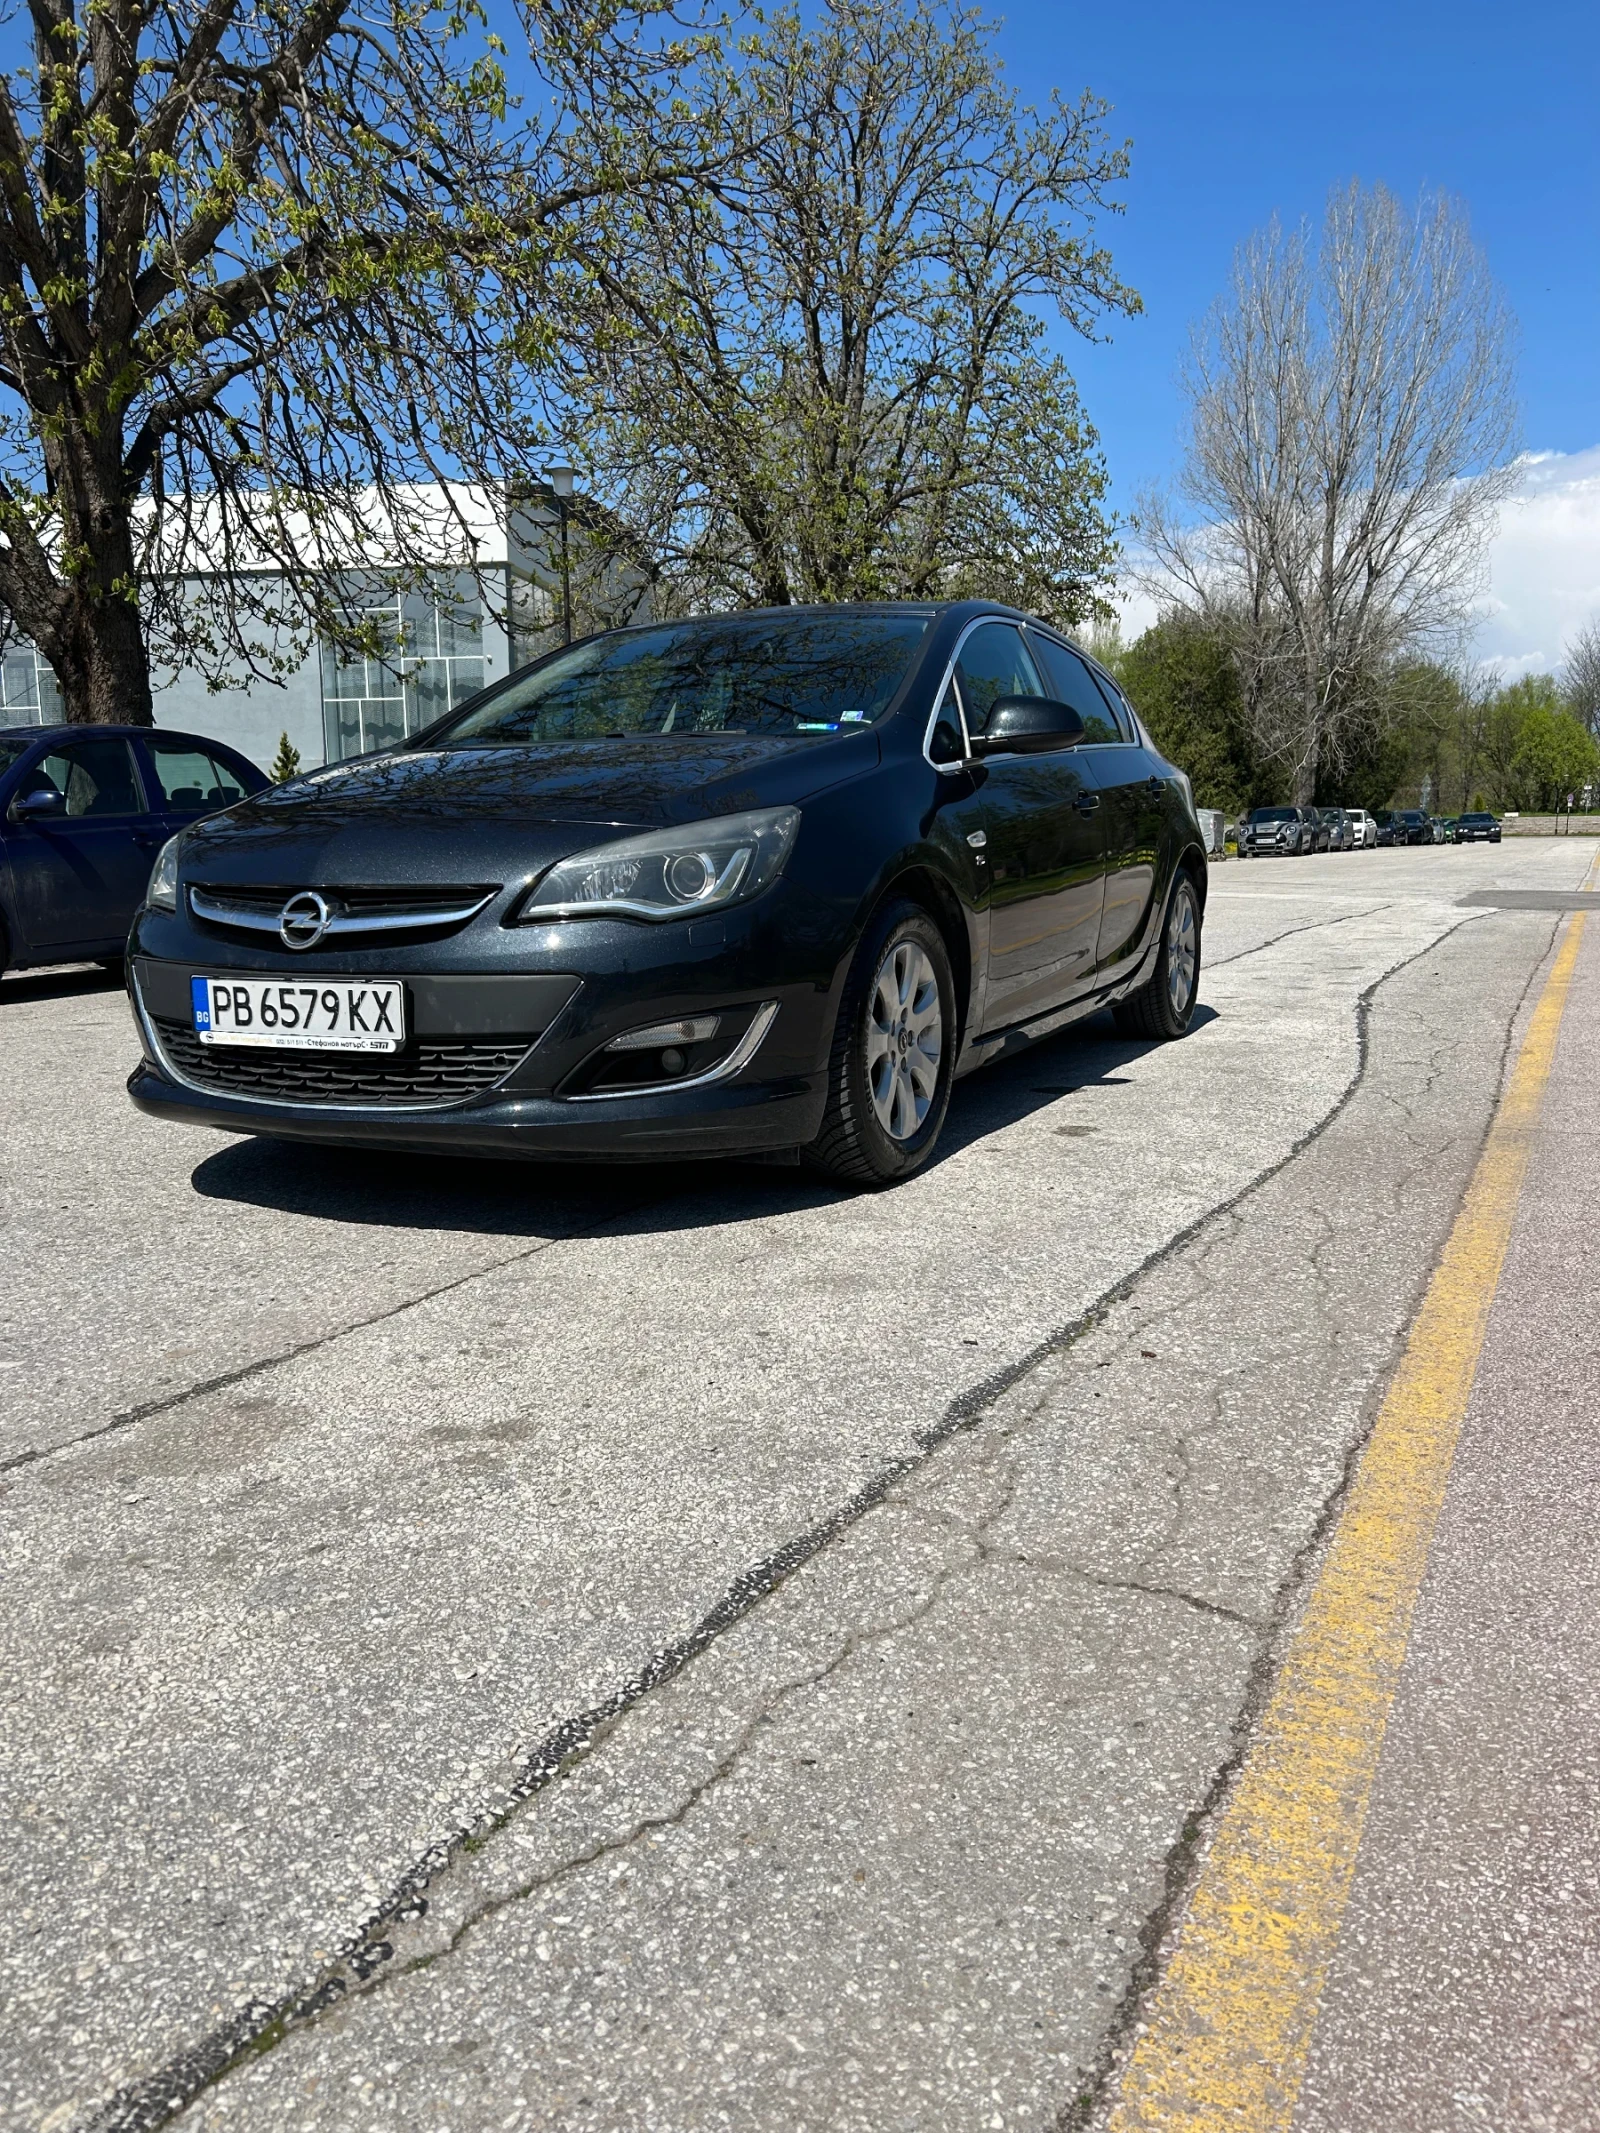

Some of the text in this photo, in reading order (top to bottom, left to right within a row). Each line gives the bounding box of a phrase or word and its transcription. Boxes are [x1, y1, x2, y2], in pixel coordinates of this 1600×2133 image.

[196, 1010, 209, 1023] BG
[213, 985, 395, 1033] PB 6579 KX
